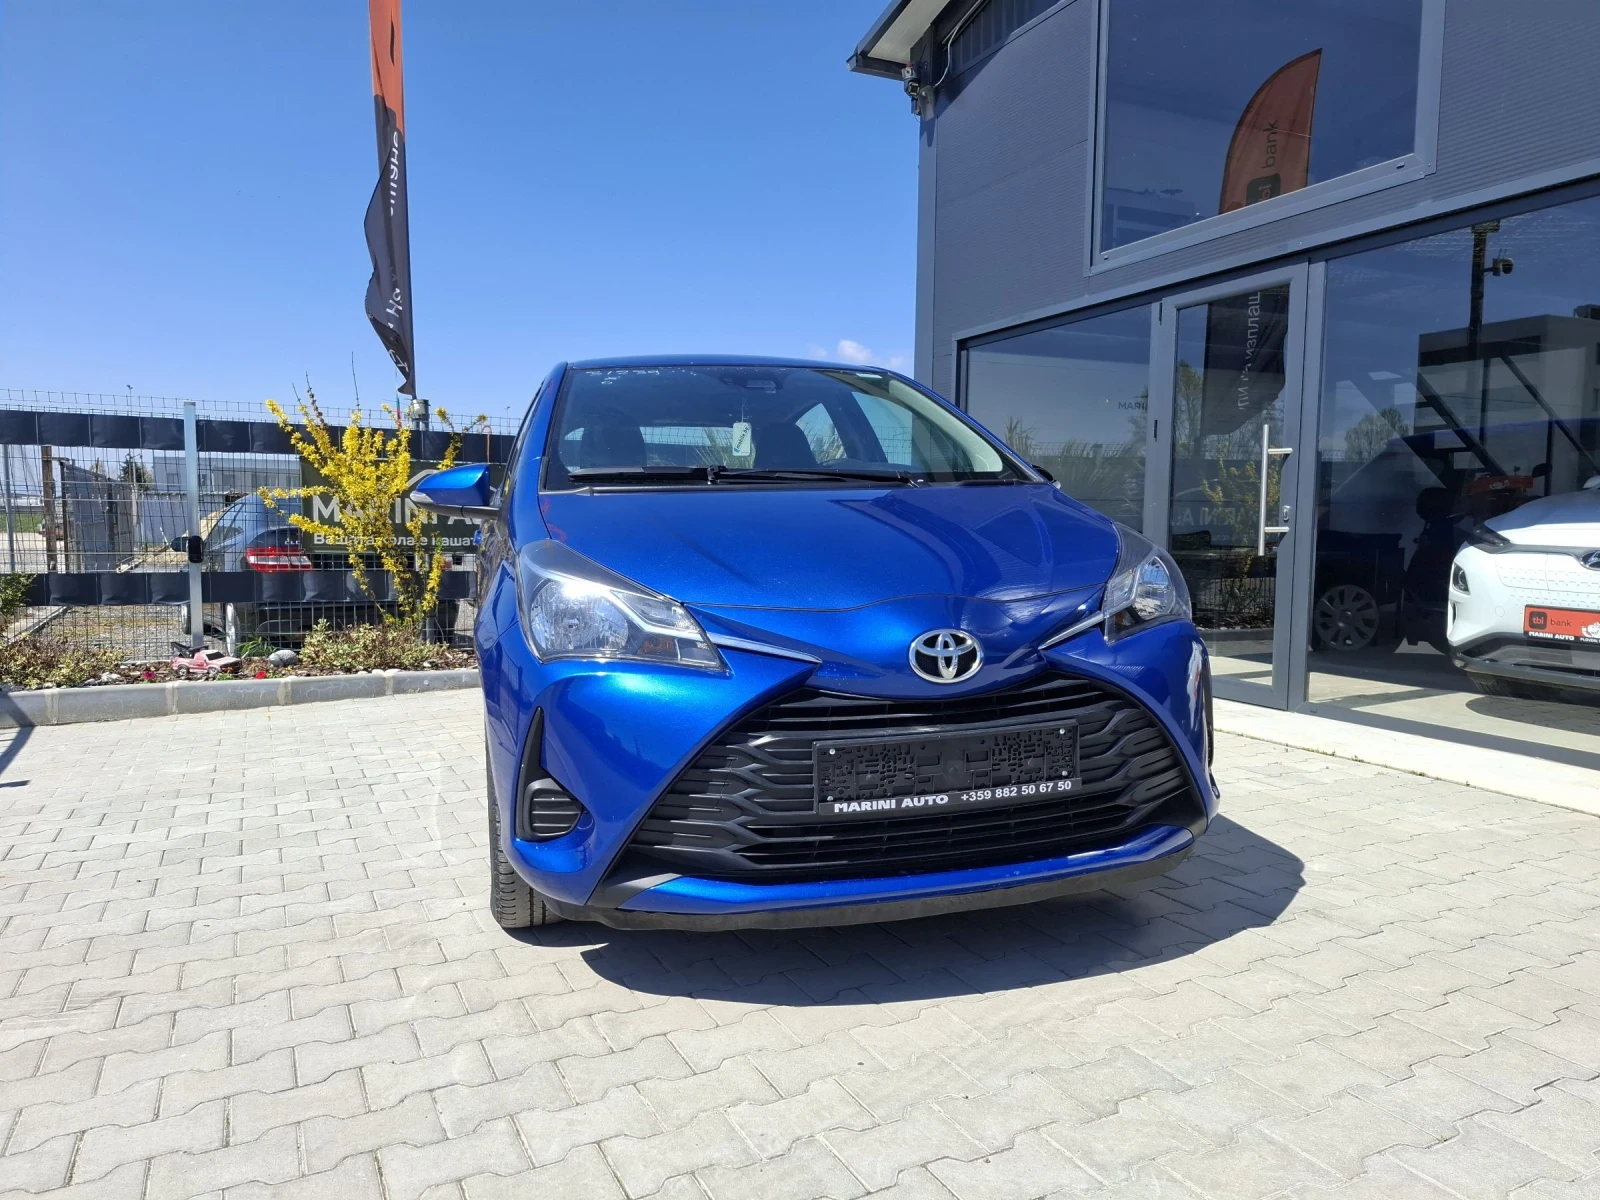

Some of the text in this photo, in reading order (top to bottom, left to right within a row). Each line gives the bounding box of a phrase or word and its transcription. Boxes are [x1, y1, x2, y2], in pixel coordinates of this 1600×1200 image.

[1258, 119, 1278, 202] bi bank
[1550, 617, 1572, 628] bank
[1528, 631, 1554, 639] MARINI
[833, 780, 1072, 813] MARINI AUTO +359 882 50 67 50
